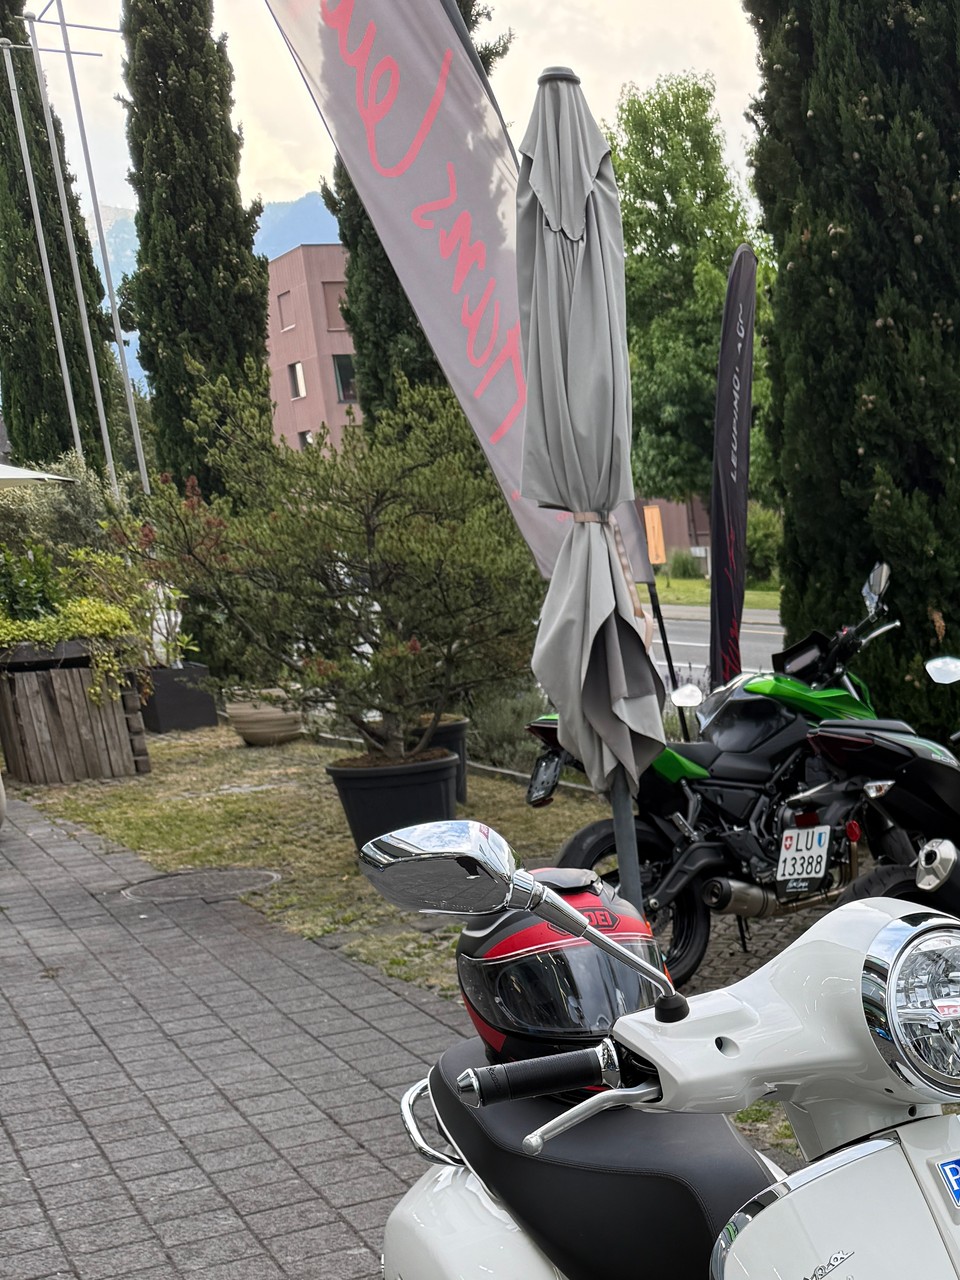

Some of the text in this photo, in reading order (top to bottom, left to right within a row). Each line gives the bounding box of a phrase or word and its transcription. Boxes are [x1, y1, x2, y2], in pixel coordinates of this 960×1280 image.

[795, 831, 815, 852] LU
[780, 854, 823, 877] 13388
[583, 911, 613, 927] OEI
